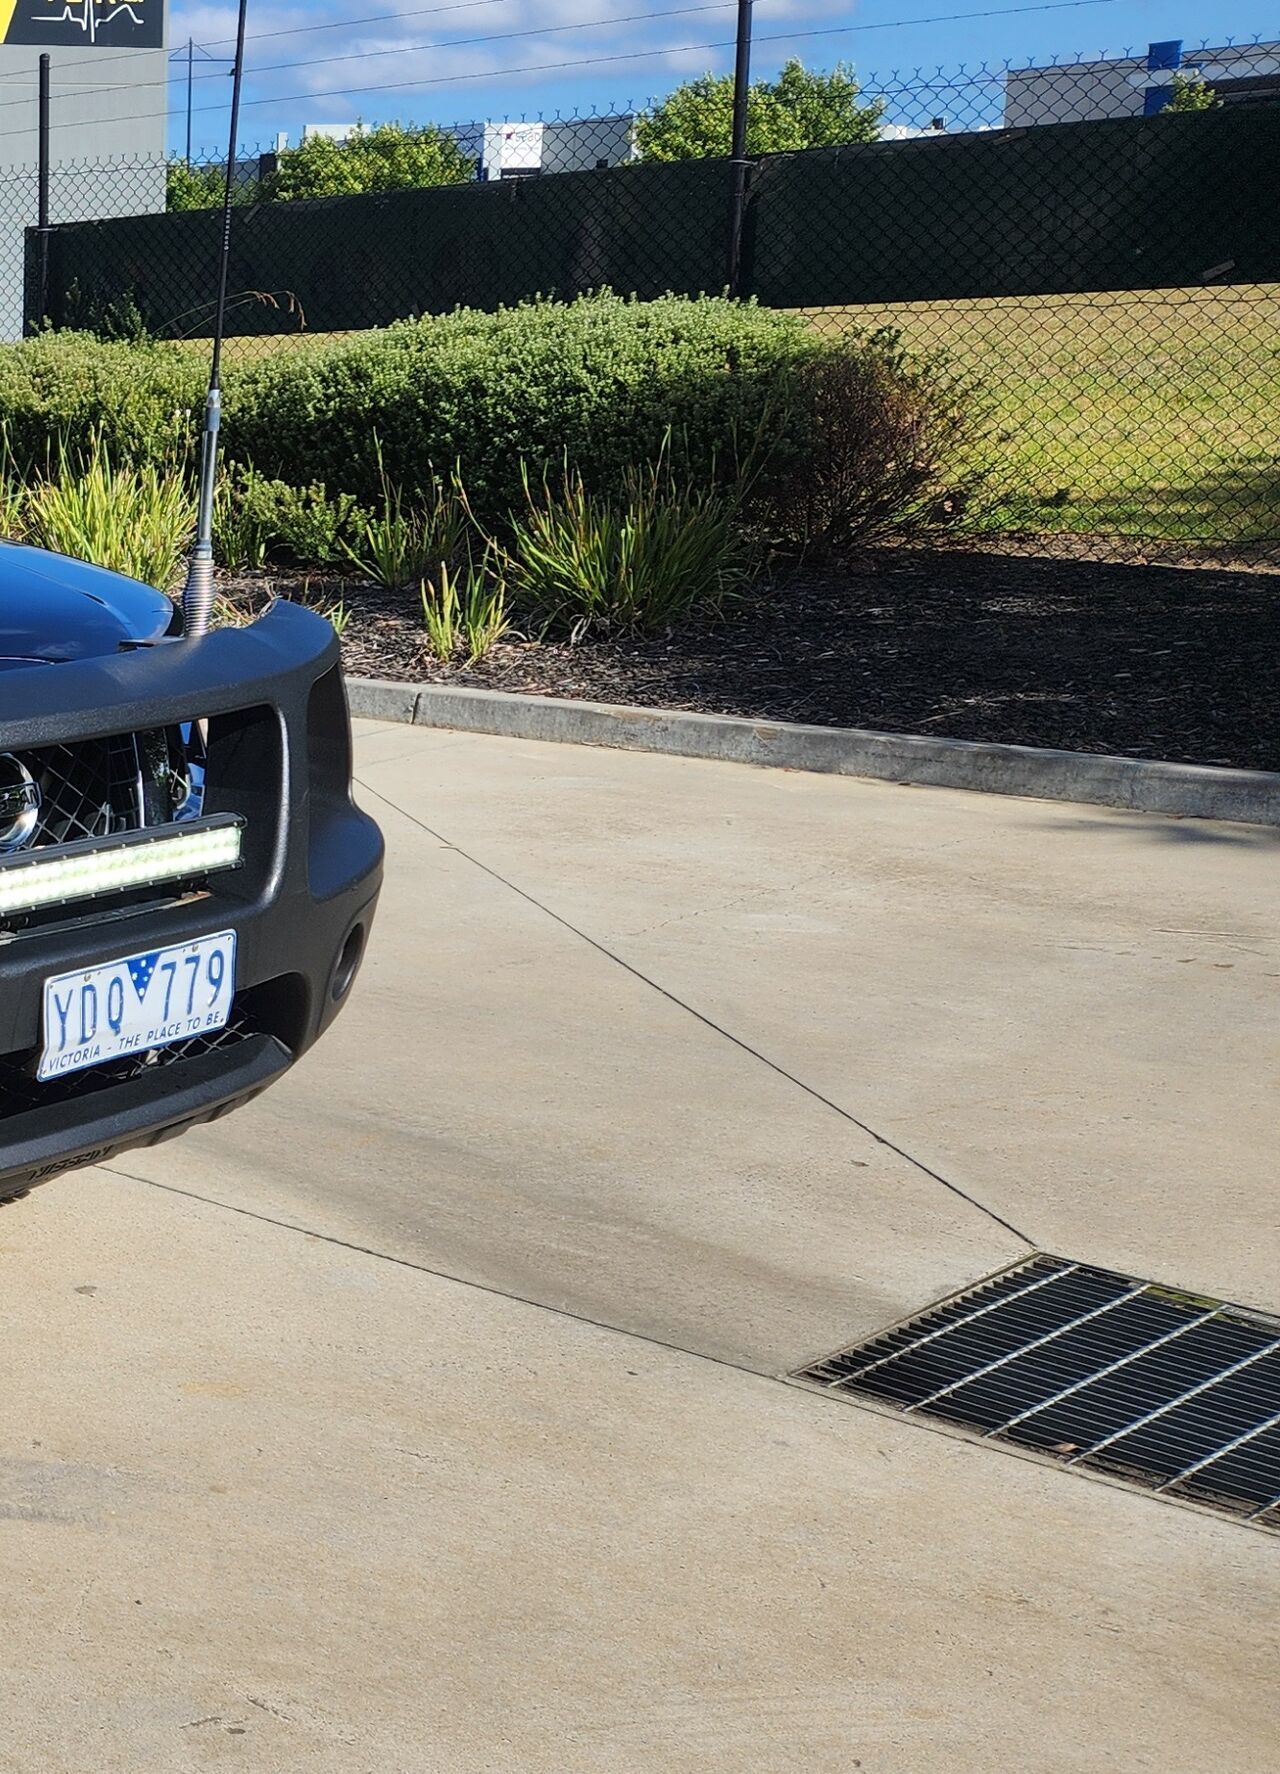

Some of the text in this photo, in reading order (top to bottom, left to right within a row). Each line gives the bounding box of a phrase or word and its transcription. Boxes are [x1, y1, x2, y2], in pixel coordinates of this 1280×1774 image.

[49, 1045, 100, 1071] VICTORIA
[120, 1033, 141, 1050] THE
[147, 1022, 181, 1042] PLACE
[186, 1017, 200, 1031] TO
[206, 1011, 220, 1026] BE
[54, 950, 224, 1052] YDQ 779
